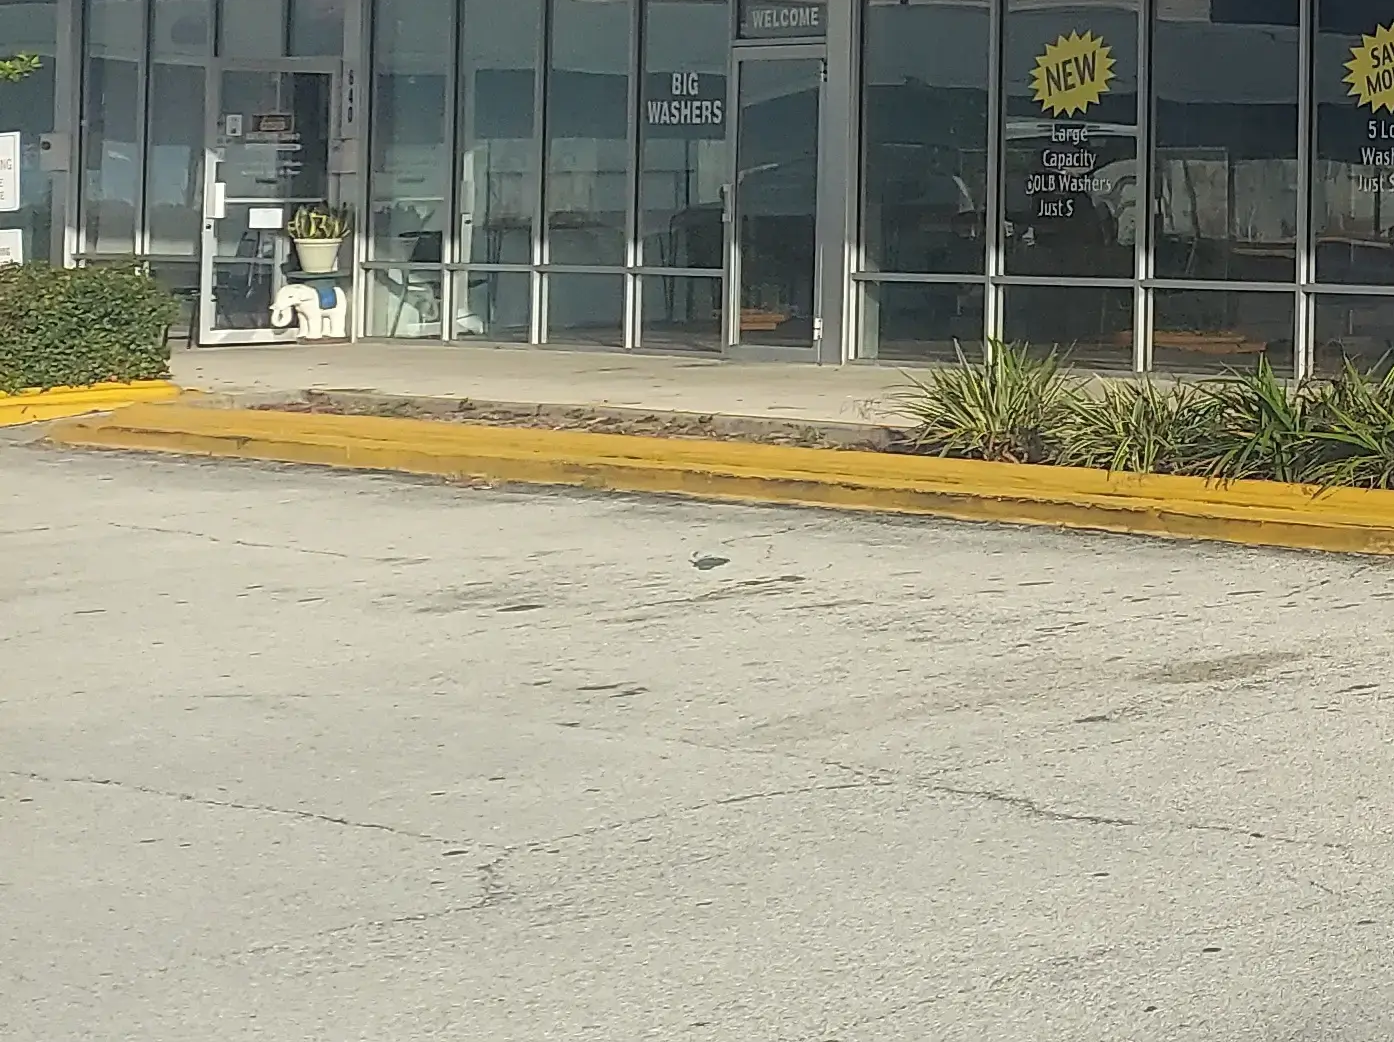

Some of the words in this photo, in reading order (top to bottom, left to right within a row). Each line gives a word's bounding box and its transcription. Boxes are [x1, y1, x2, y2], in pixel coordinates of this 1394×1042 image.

[752, 7, 819, 28] WELCOME
[671, 72, 699, 95] BIG
[1045, 51, 1096, 96] NEW
[648, 100, 722, 124] WASHERS
[1052, 124, 1088, 145] Large
[1368, 120, 1377, 138] 5
[1042, 149, 1096, 170] Capacity
[1058, 175, 1112, 192] Washers
[1358, 174, 1385, 193] Just
[1038, 200, 1064, 218] Just
